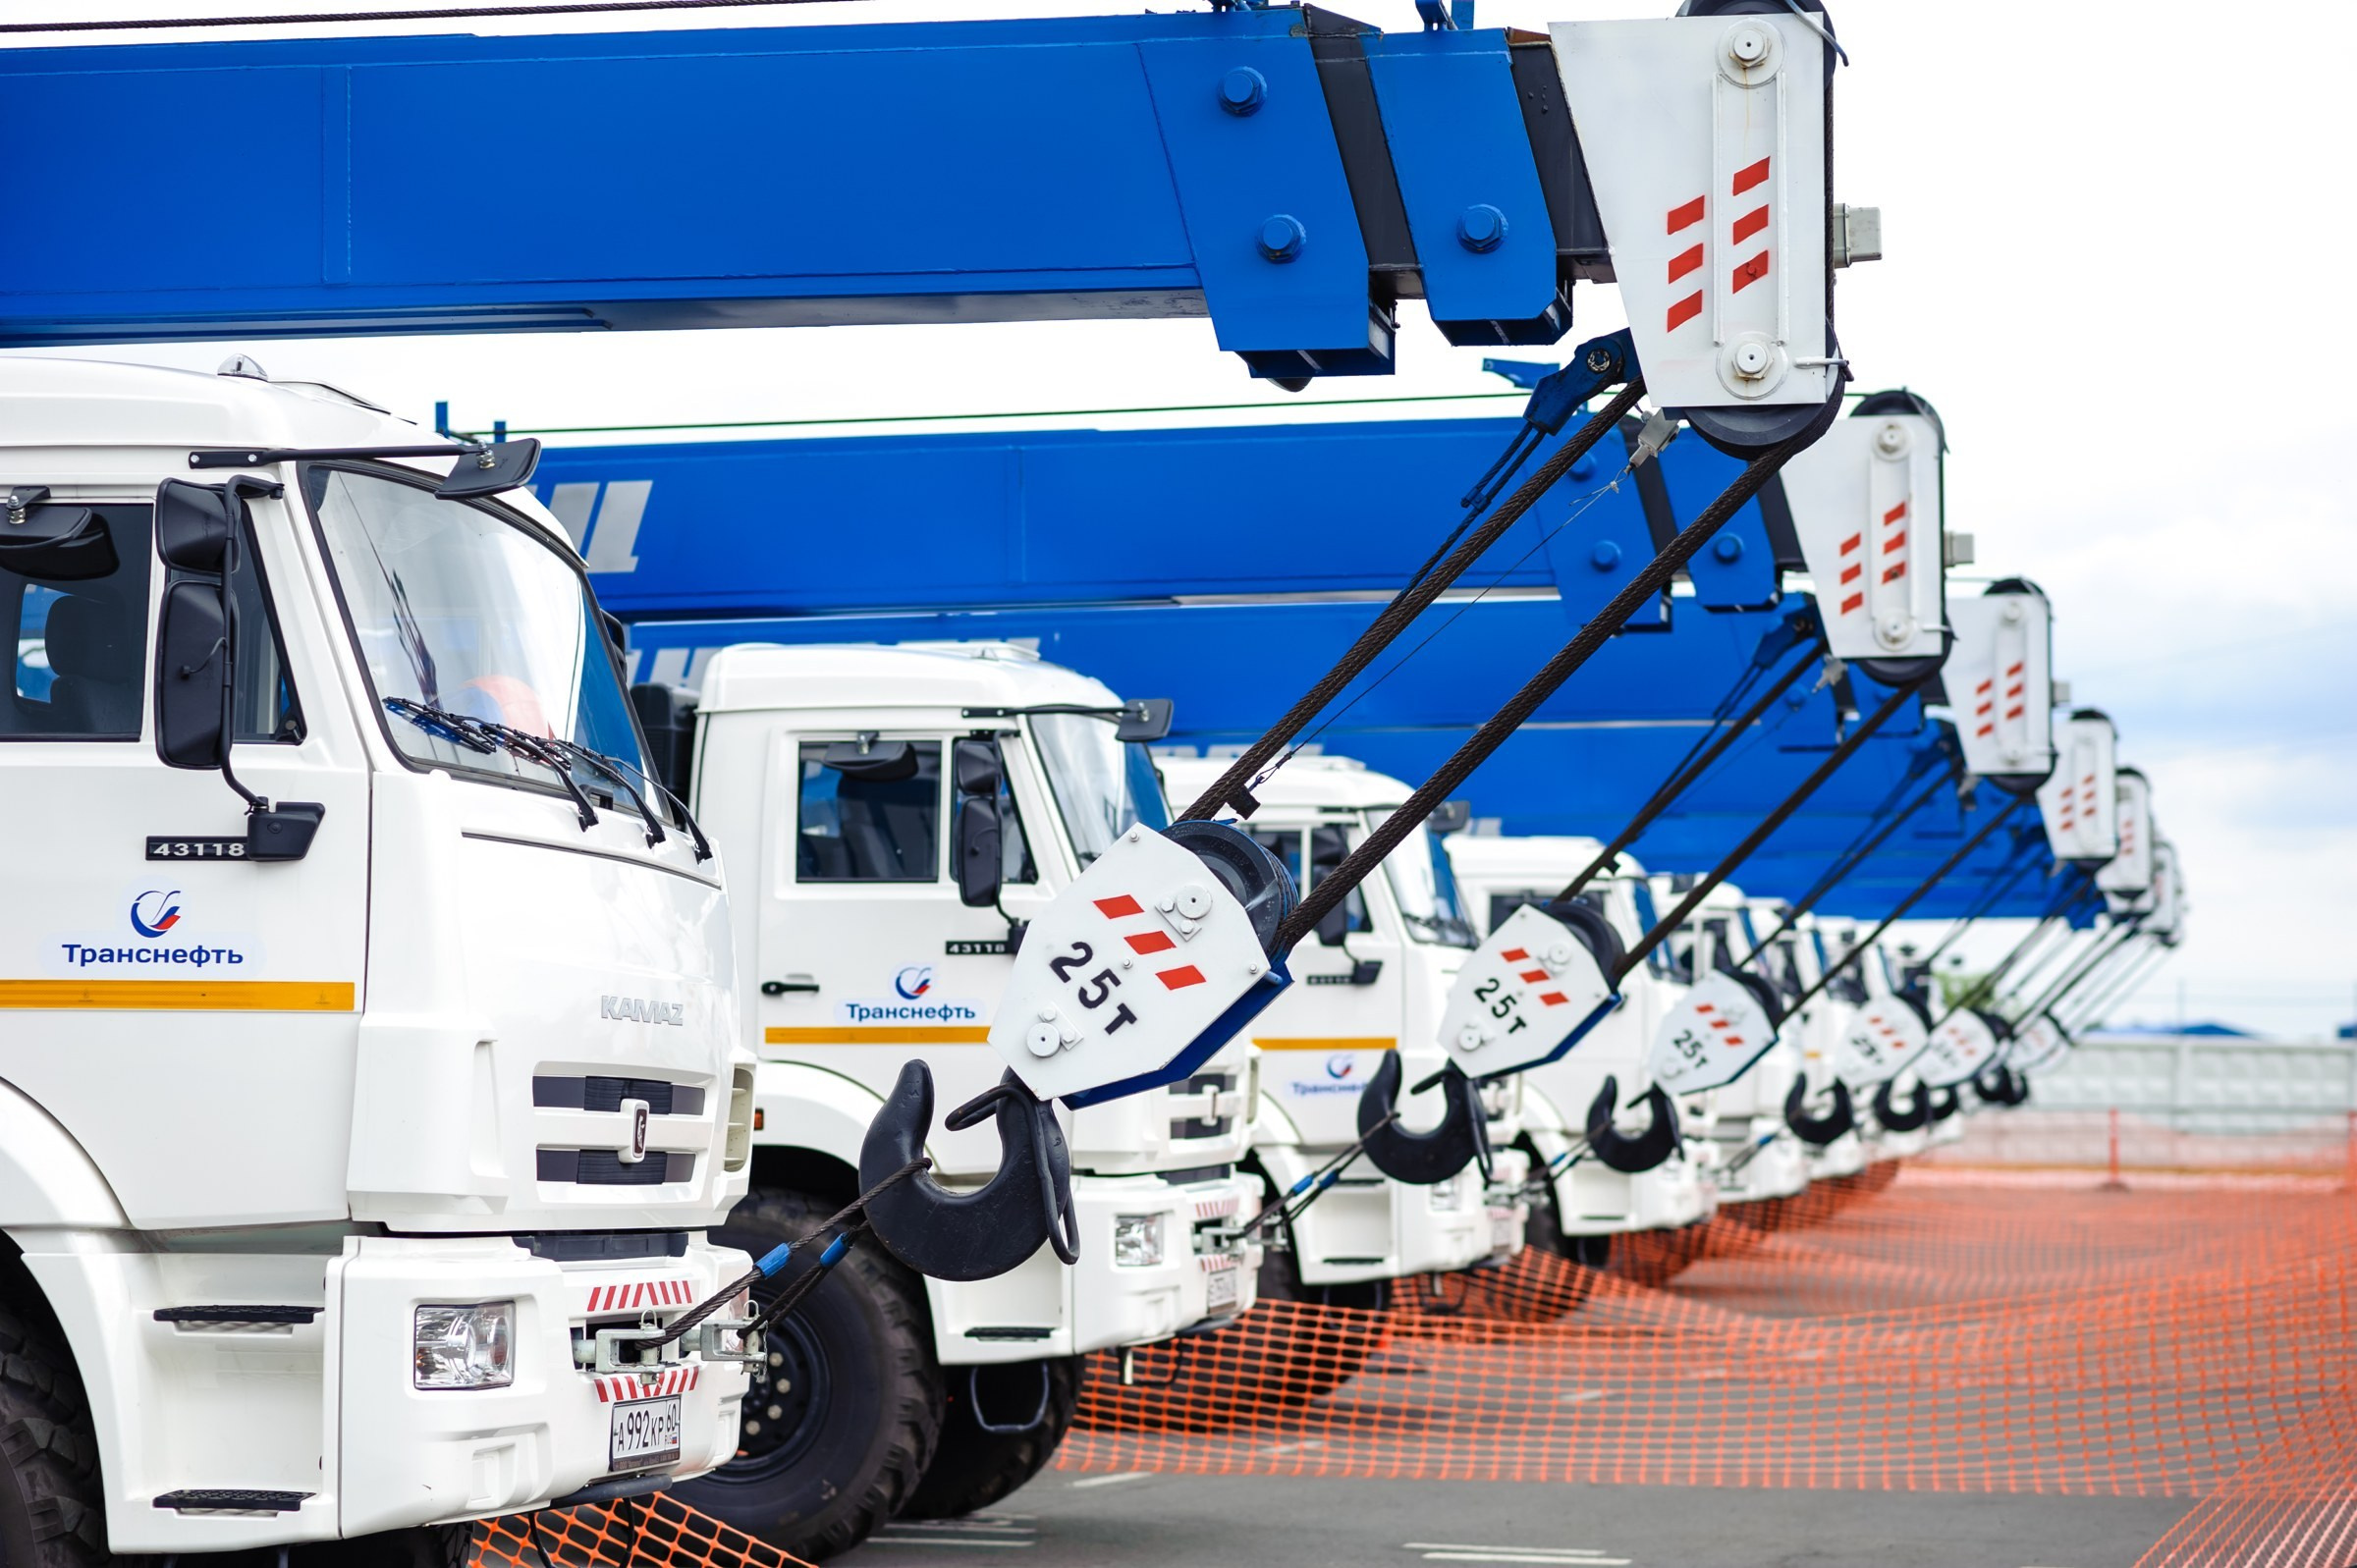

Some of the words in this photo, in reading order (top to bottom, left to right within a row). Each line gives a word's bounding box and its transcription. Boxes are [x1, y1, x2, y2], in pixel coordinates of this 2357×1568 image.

[152, 842, 246, 857] 43118
[61, 944, 245, 968] Транснефть
[949, 943, 1006, 954] 43118
[600, 995, 684, 1027] KAMAZ
[845, 1003, 976, 1023] Транснефть
